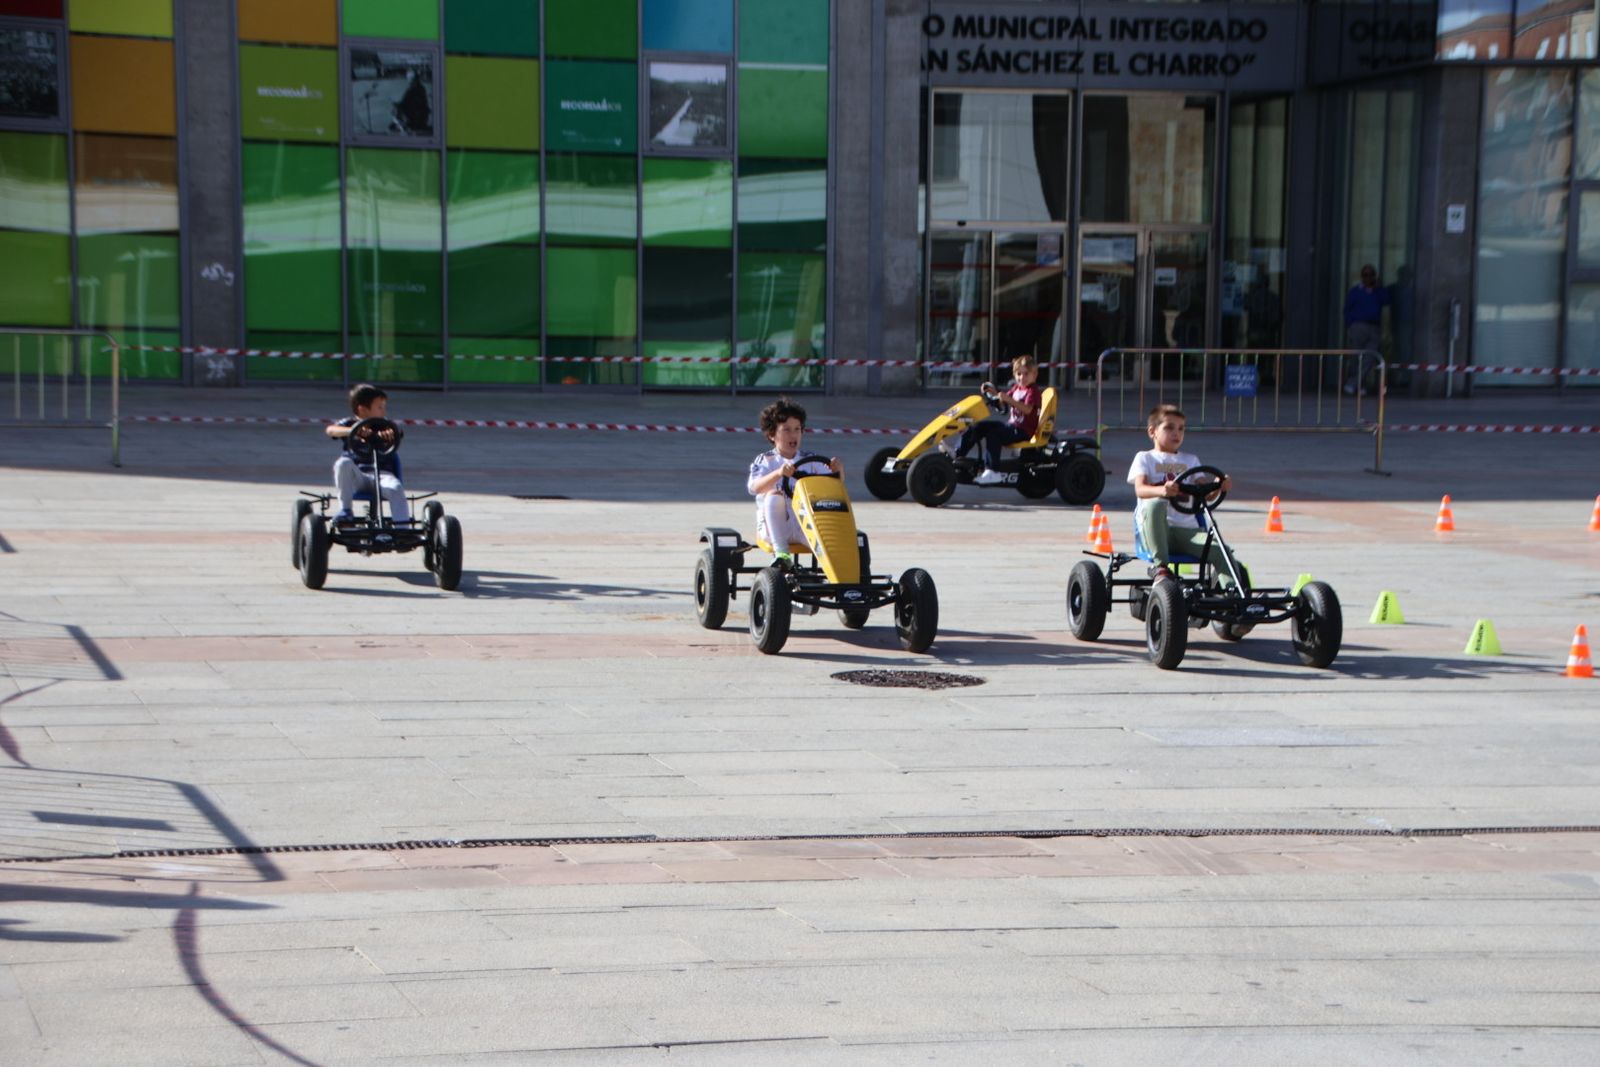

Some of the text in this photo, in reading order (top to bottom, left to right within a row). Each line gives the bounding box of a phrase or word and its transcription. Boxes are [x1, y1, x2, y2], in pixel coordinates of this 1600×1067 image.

[953, 16, 1101, 41] MUNICIPAL
[1110, 18, 1267, 43] INTEGRADO
[956, 44, 1084, 76] SÁNCHEZ
[1092, 52, 1121, 75] EL
